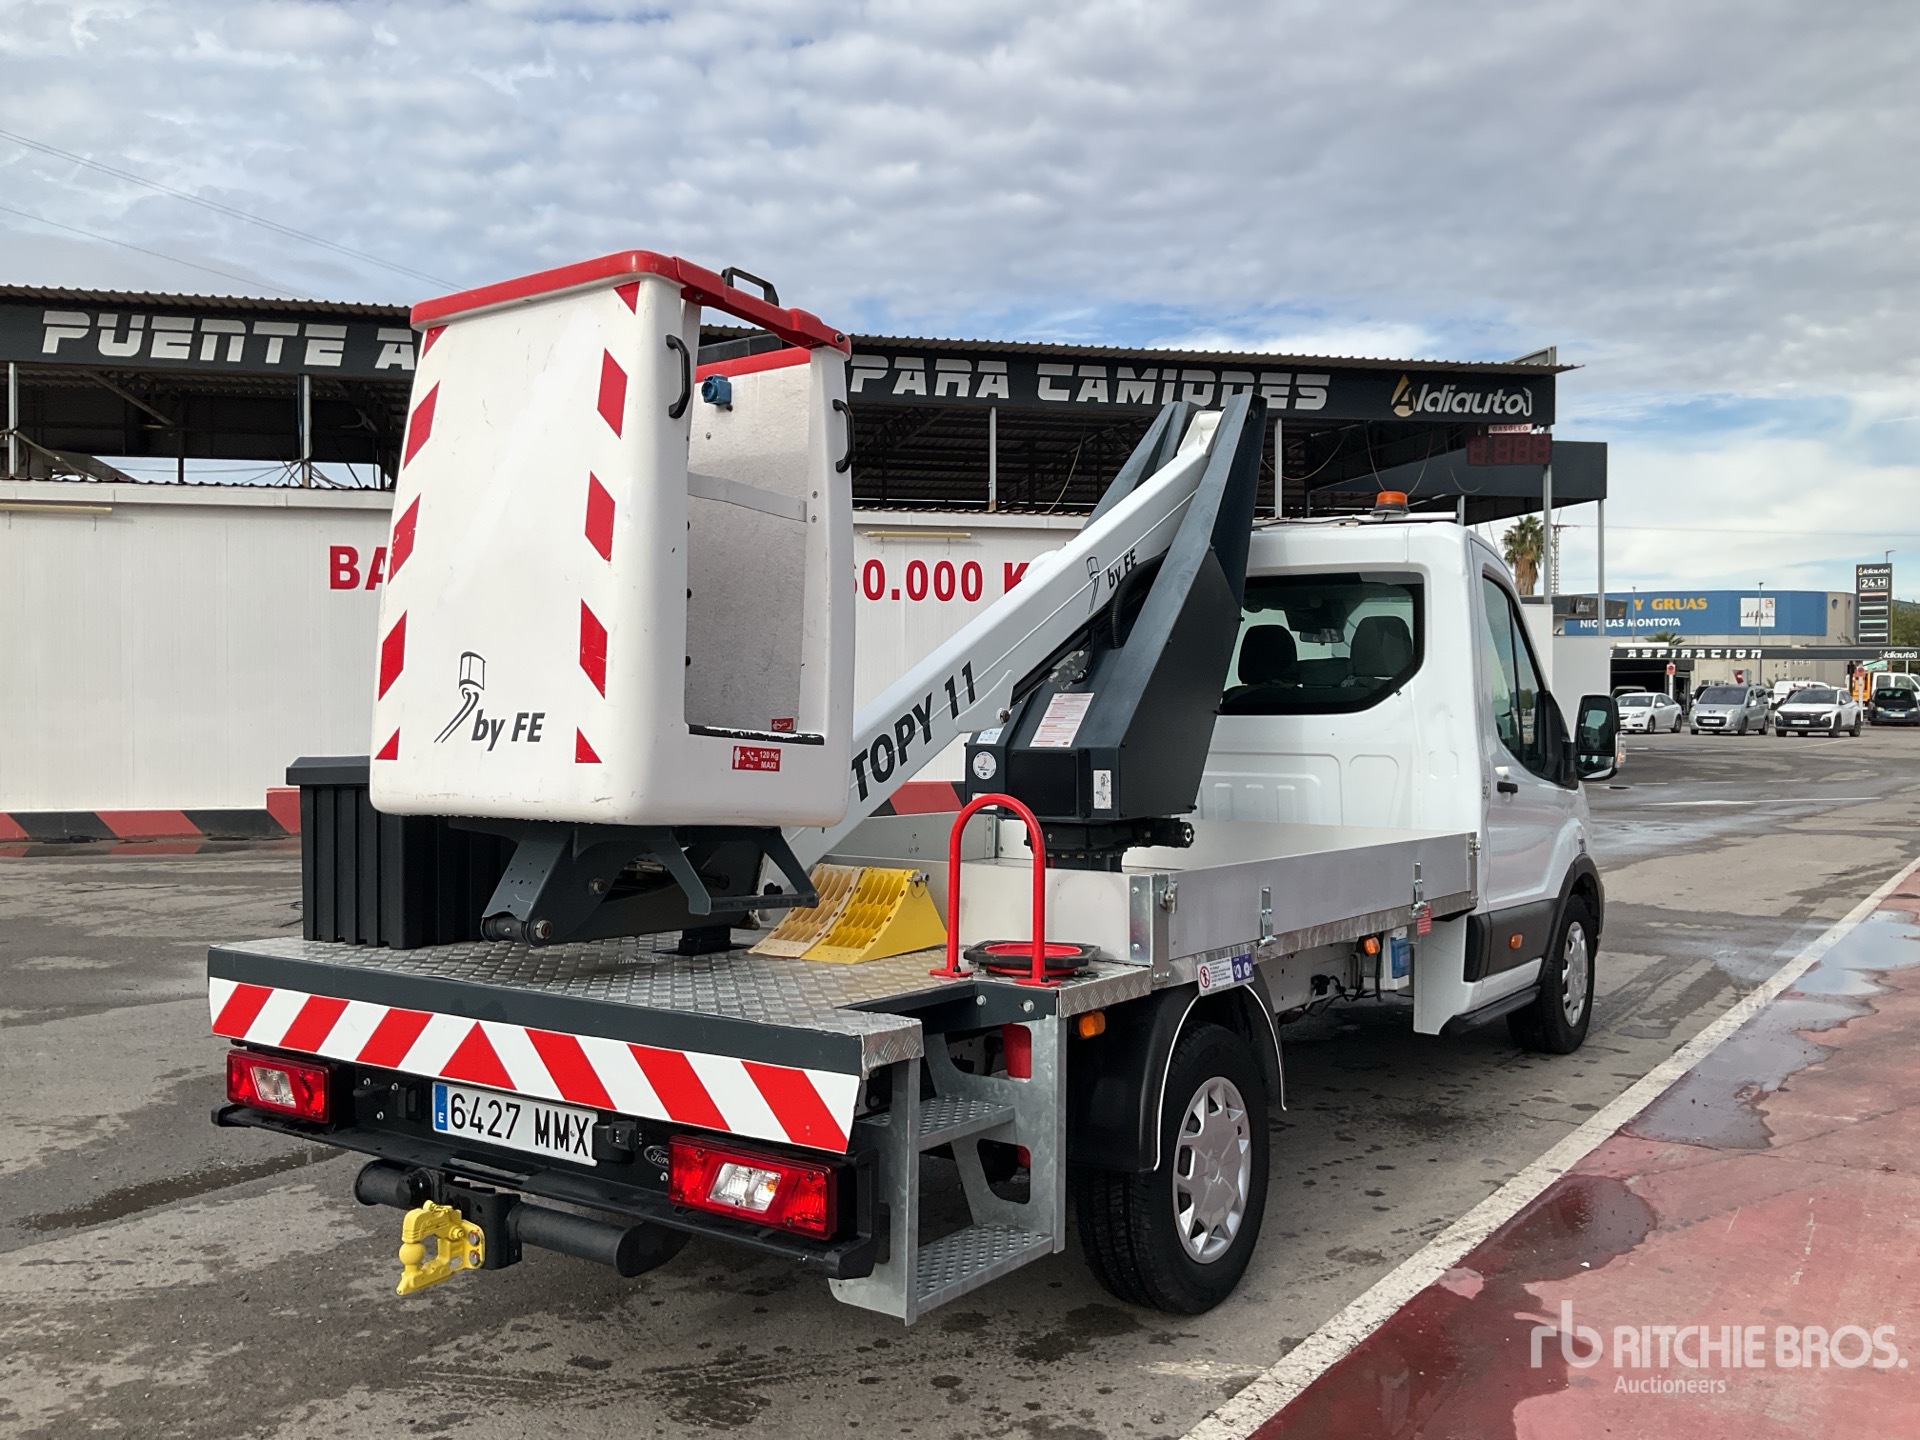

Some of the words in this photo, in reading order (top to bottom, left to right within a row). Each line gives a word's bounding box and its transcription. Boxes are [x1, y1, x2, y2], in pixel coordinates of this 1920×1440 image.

[41, 310, 348, 367] PUENTE
[850, 353, 1010, 399] PARA
[1036, 363, 1330, 411] CAMIONES
[1391, 374, 1524, 417] Aldiauto
[854, 559, 983, 602] 0.000
[1107, 567, 1121, 590] by
[1124, 548, 1137, 576] FE
[1580, 619, 1624, 628] NICLAS
[1627, 618, 1681, 627] MONTOYA
[1634, 598, 1644, 611] Y
[1651, 597, 1708, 611] GRUAS
[1627, 649, 1763, 659] ASPIRACION
[471, 709, 506, 751] by
[511, 712, 546, 742] FE
[851, 692, 933, 803] TOPY
[944, 660, 976, 720] 11
[760, 751, 770, 759] 120
[771, 752, 779, 761] Kg
[761, 761, 777, 769] MAXI
[438, 1112, 445, 1123] E
[450, 1092, 521, 1140] 6427
[535, 1107, 590, 1157] MMX
[651, 1149, 669, 1165] For
